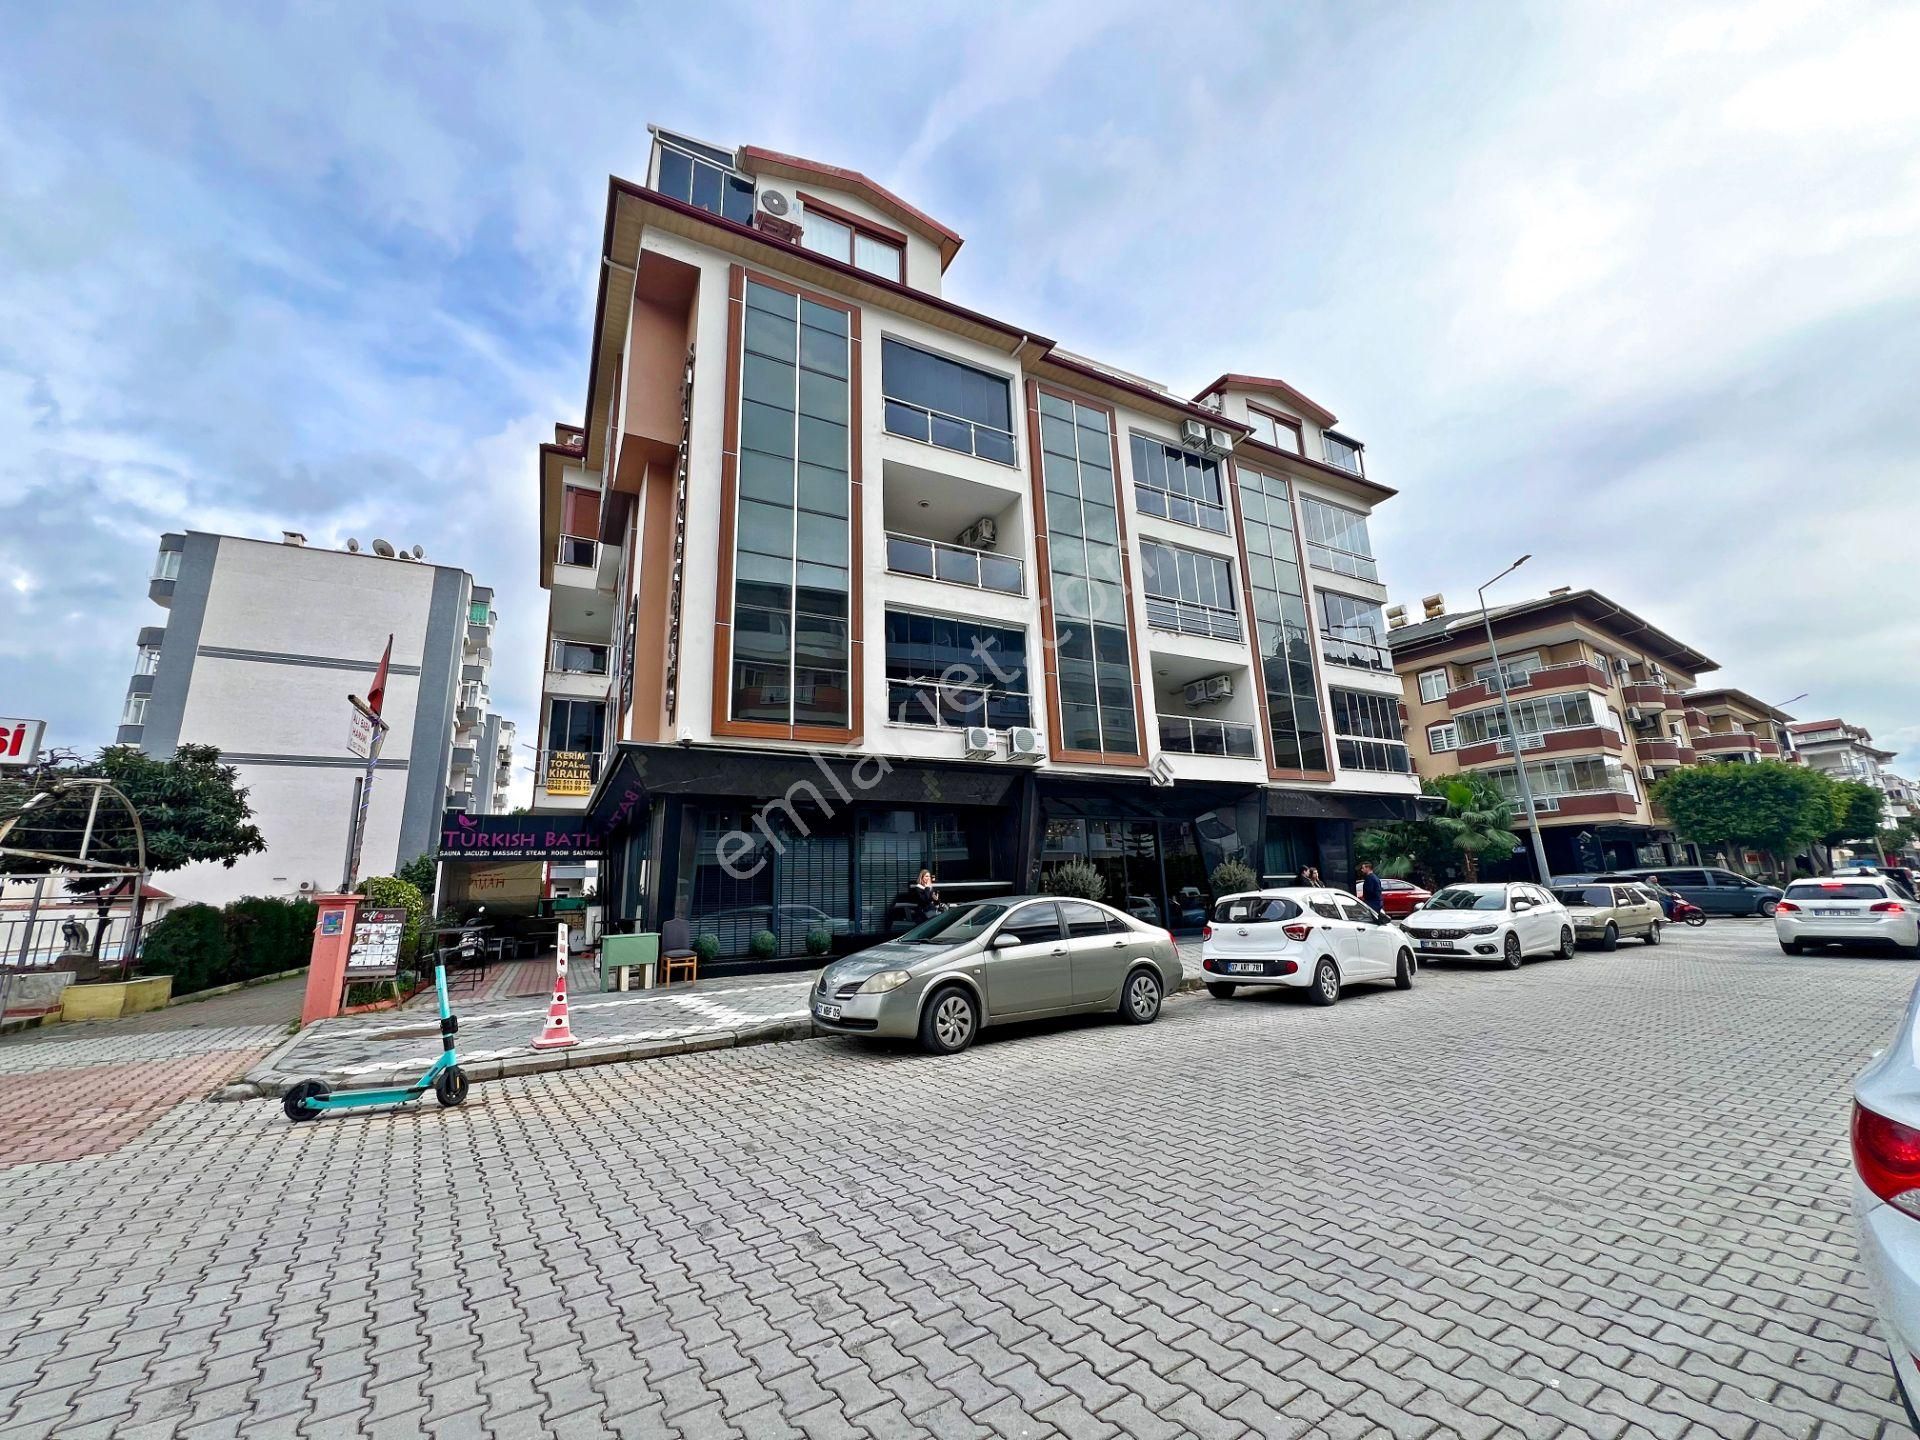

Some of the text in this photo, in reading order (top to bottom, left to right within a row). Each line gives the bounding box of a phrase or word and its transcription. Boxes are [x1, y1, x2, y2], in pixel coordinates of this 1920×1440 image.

[557, 751, 585, 760] KERİM
[549, 768, 590, 778] KİRALIK
[443, 831, 600, 847] TURKISH BATH
